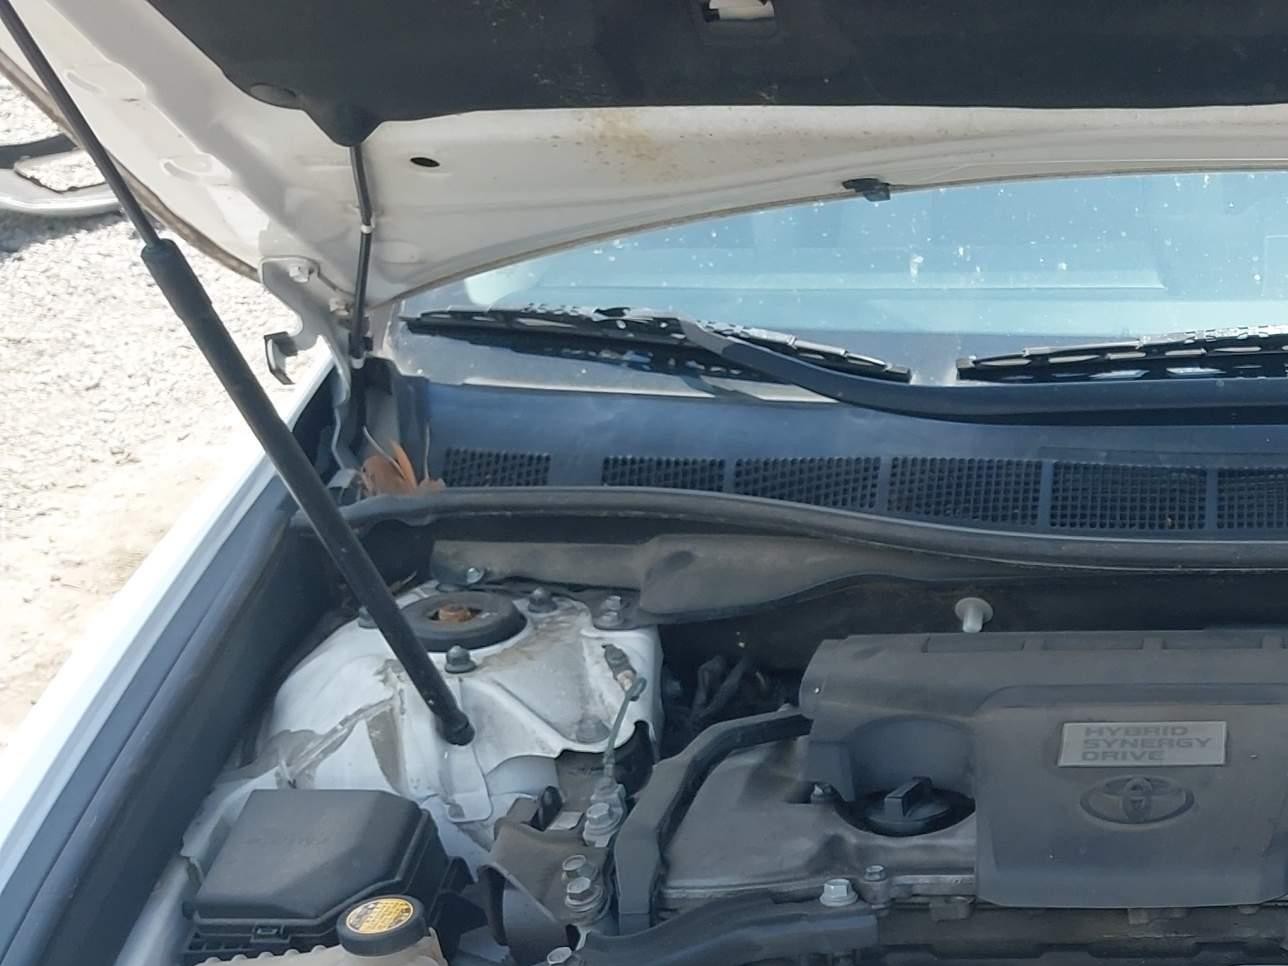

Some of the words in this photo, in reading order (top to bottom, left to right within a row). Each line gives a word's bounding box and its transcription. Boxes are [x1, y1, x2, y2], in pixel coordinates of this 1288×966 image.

[1083, 726, 1189, 737] HYBRID
[1082, 737, 1212, 749] SYNERGY
[1080, 750, 1166, 761] DRIVE
